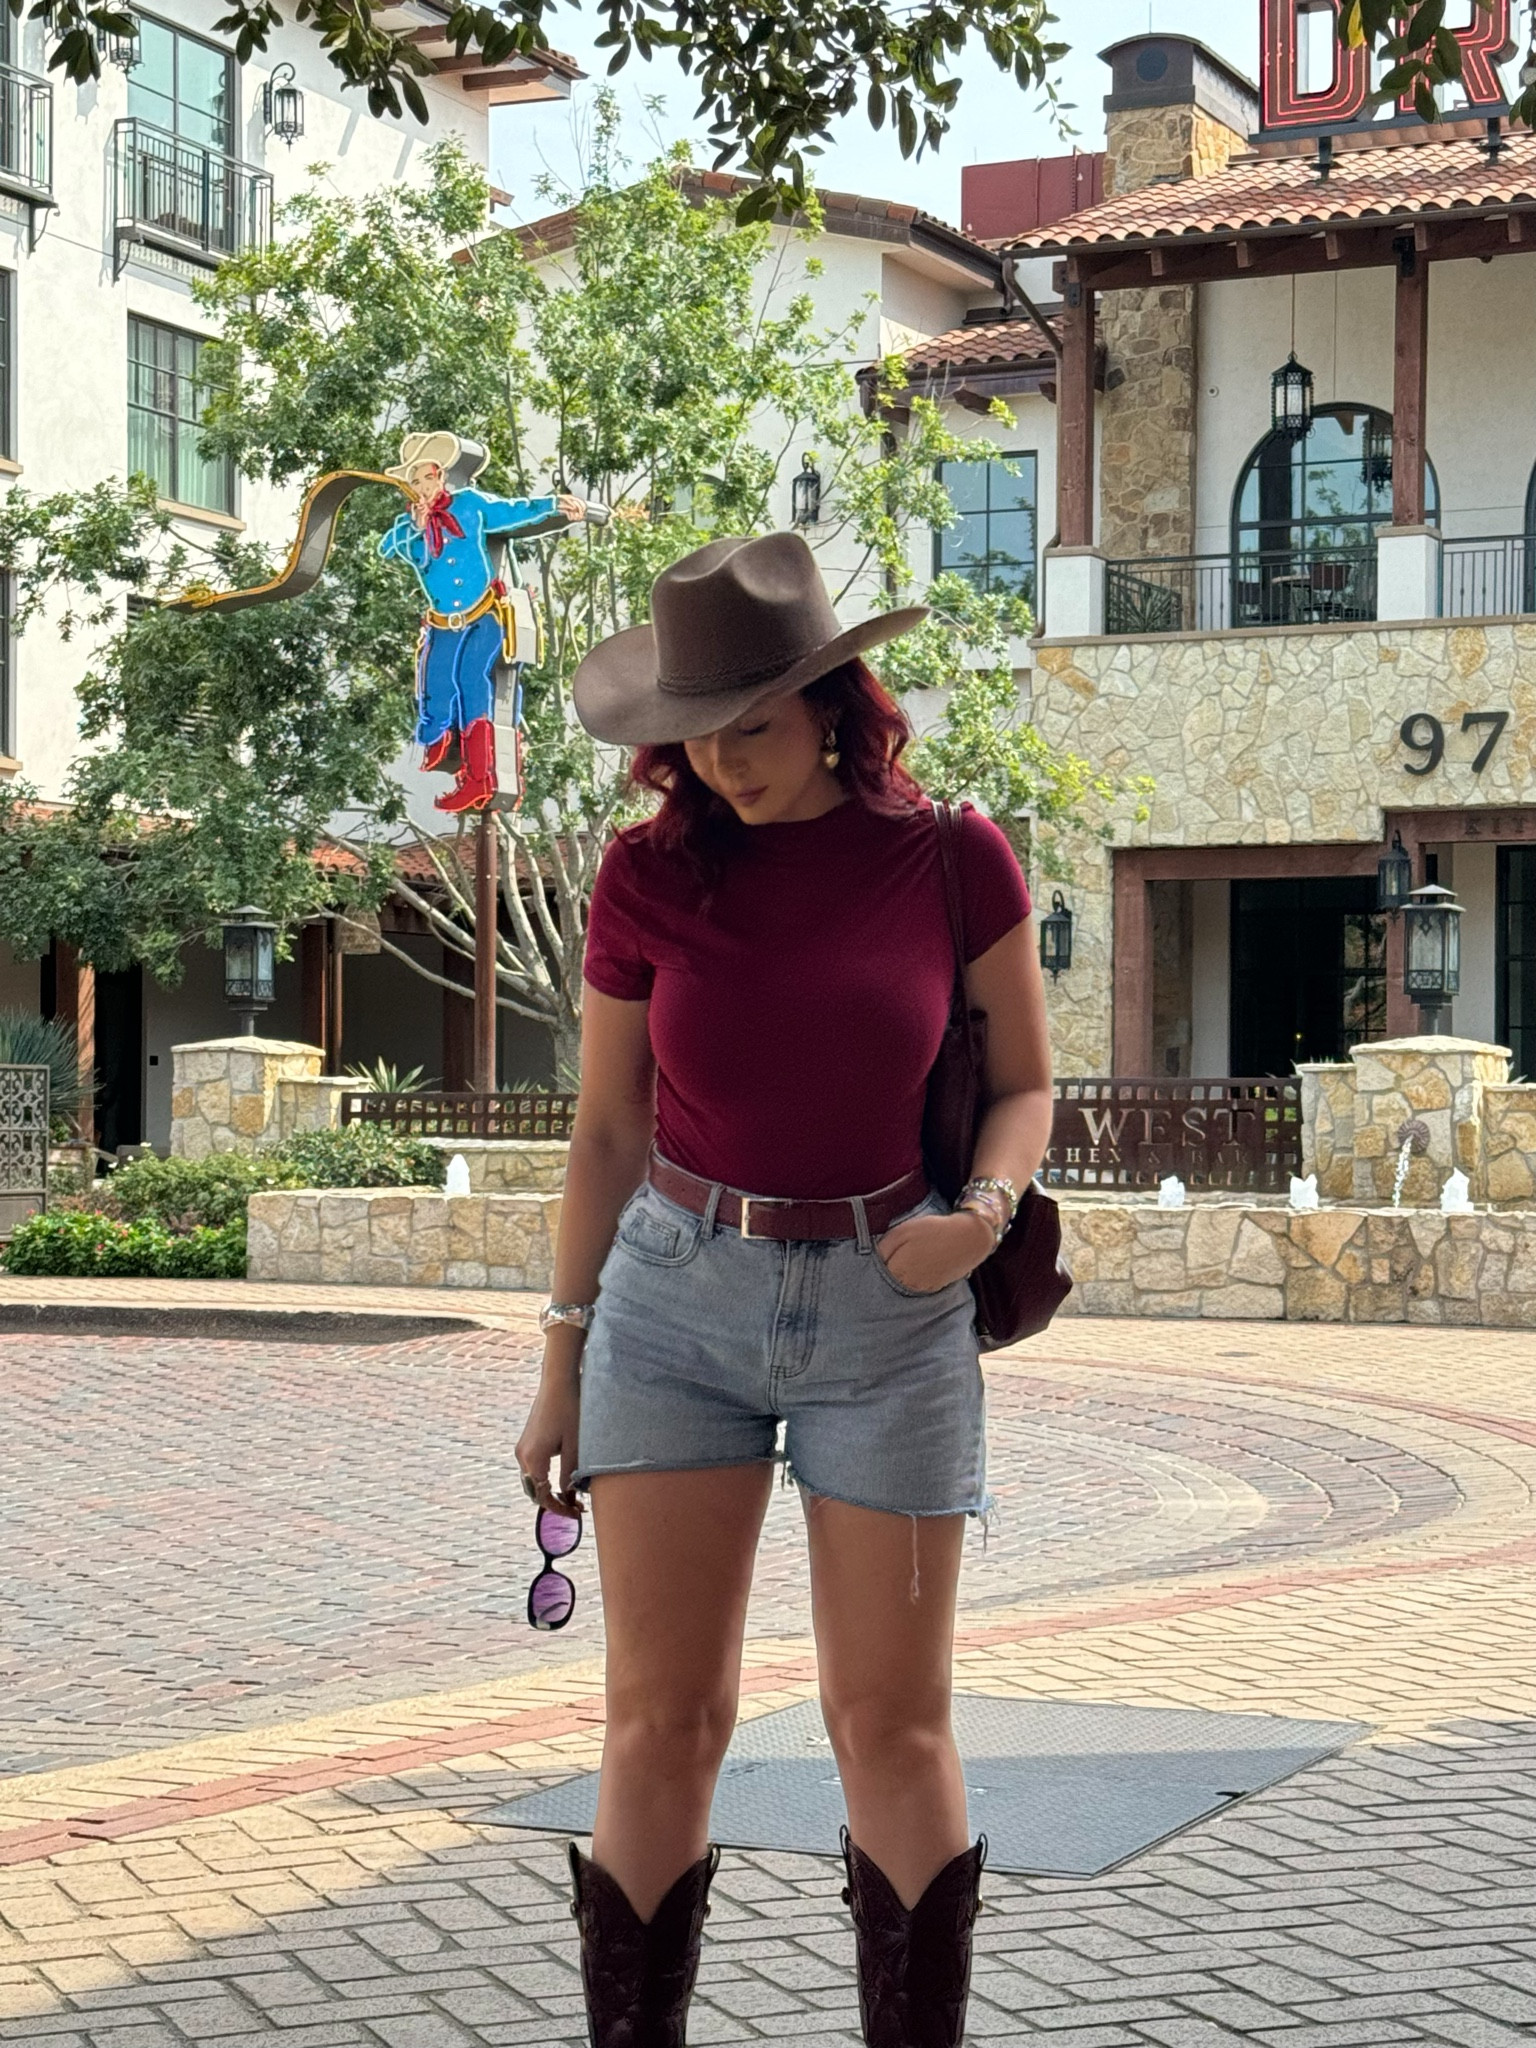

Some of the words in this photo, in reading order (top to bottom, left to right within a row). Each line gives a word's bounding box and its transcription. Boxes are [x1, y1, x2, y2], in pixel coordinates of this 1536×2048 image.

[1260, 0, 1512, 129] DR
[1399, 711, 1509, 776] 97
[1077, 1106, 1257, 1148] WEST
[1045, 1147, 1122, 1164] CHEN
